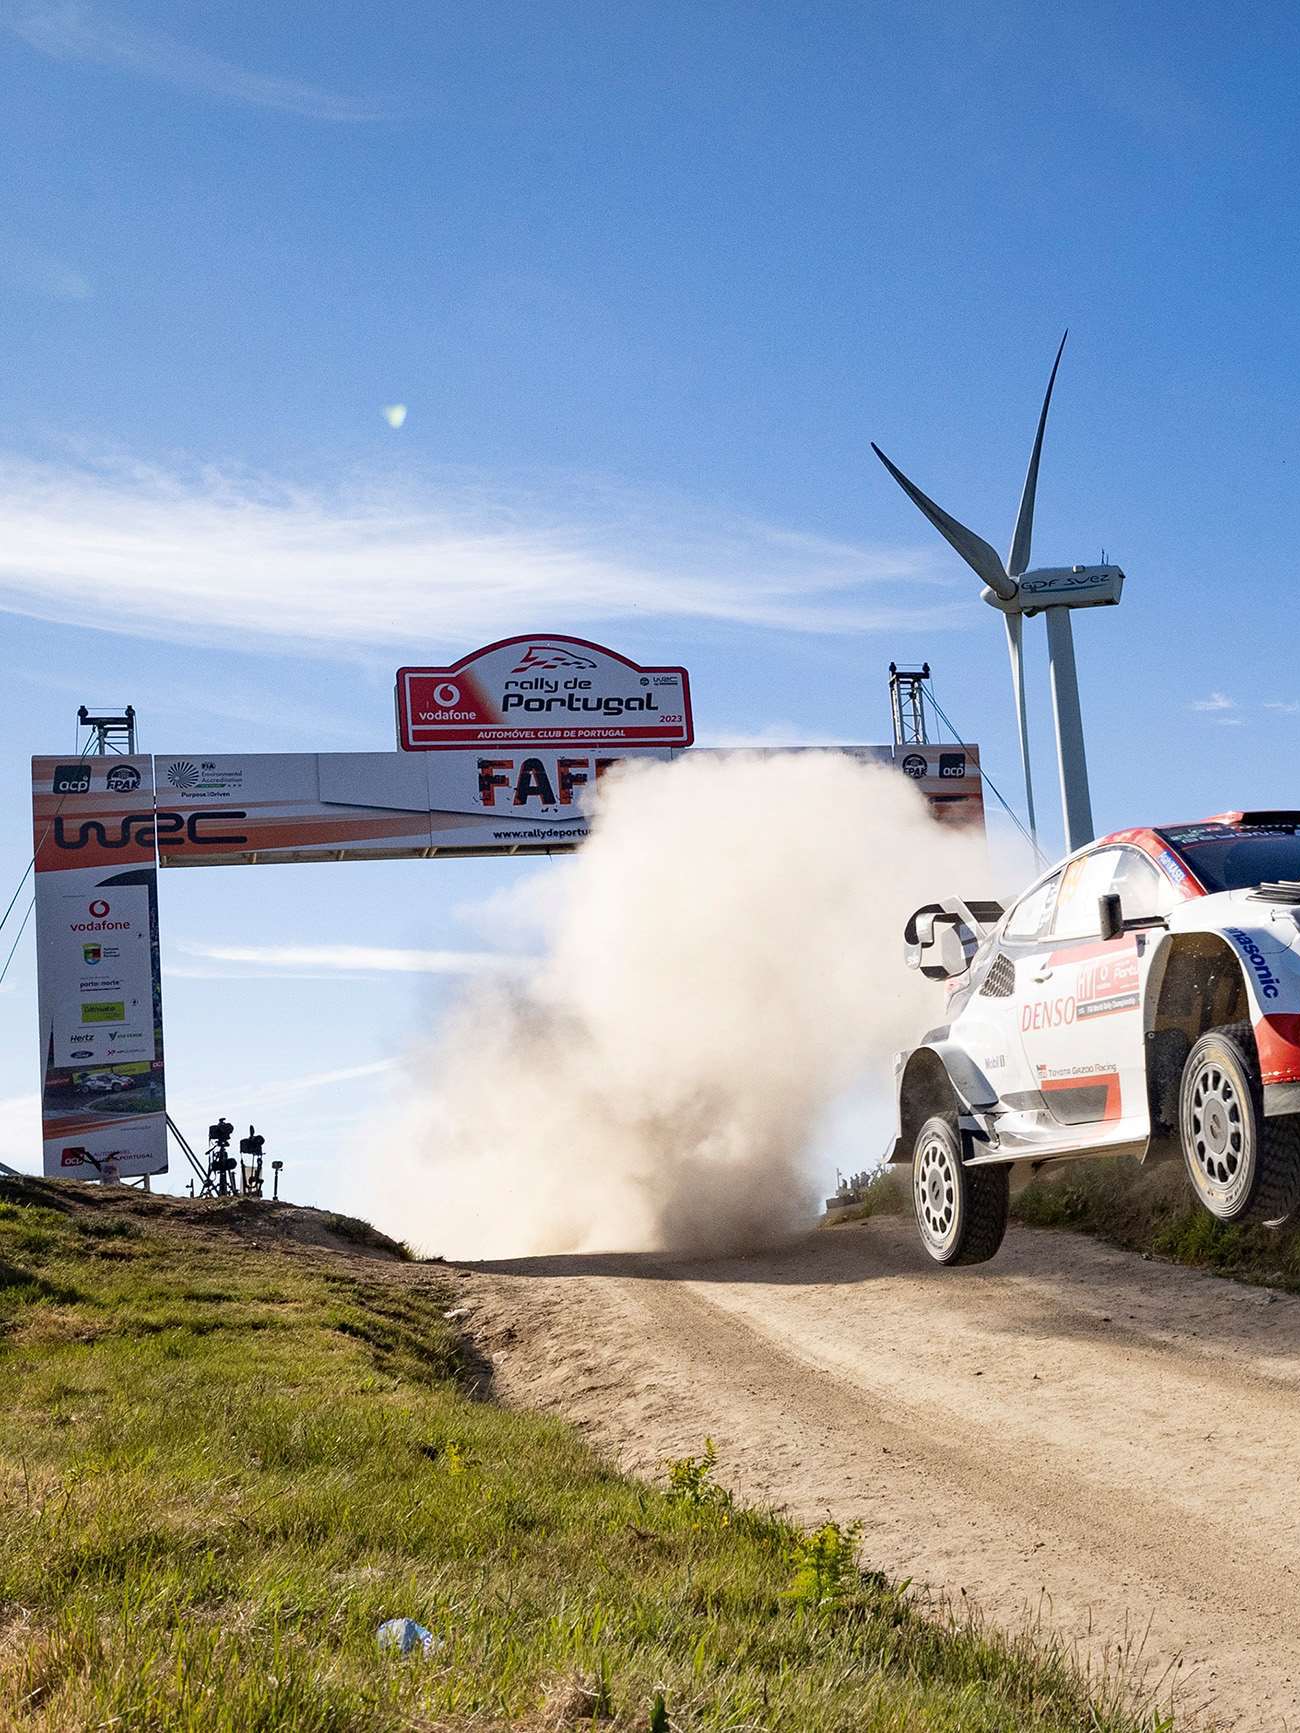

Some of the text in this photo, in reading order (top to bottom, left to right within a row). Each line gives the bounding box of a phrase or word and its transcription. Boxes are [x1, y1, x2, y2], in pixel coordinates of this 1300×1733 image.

[504, 677, 592, 693] rally de
[502, 692, 659, 716] Portugal
[419, 710, 477, 721] vodafone
[659, 714, 683, 723] 2023
[477, 728, 626, 739] AUTOMÓVEL CLUB DE PORTUGAL
[59, 780, 88, 793] acp
[54, 811, 247, 849] WRC
[70, 920, 130, 932] vodafone
[1022, 996, 1075, 1031] DENSO
[70, 1034, 95, 1043] Hertz
